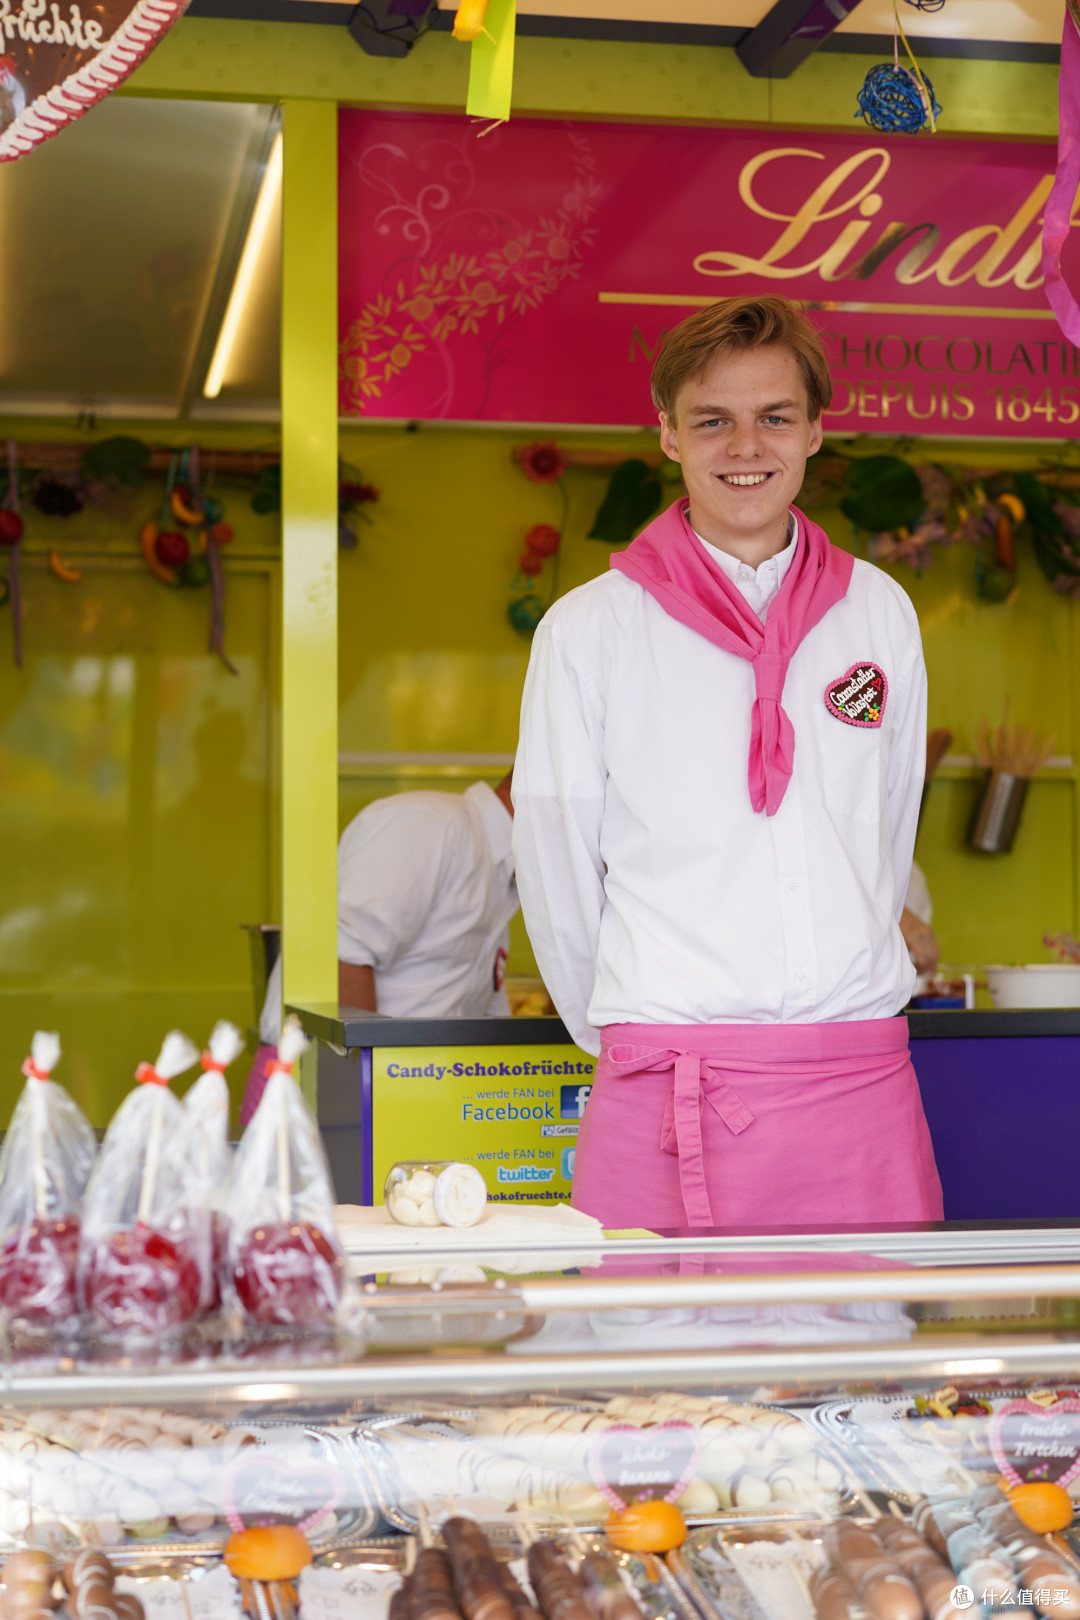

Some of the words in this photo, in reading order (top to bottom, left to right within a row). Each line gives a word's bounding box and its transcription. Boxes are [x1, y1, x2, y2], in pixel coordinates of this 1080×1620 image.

[986, 385, 1080, 424] 1845
[842, 687, 878, 719] Volksfest
[387, 1060, 594, 1080] Candy-Schokofrüchte
[475, 1089, 510, 1099] werde
[512, 1088, 534, 1098] FAN
[537, 1087, 554, 1098] bei
[462, 1101, 555, 1121] Facebook
[476, 1150, 510, 1160] werde
[513, 1149, 535, 1159] FAN
[538, 1148, 555, 1158] bei
[498, 1166, 555, 1182] twitter
